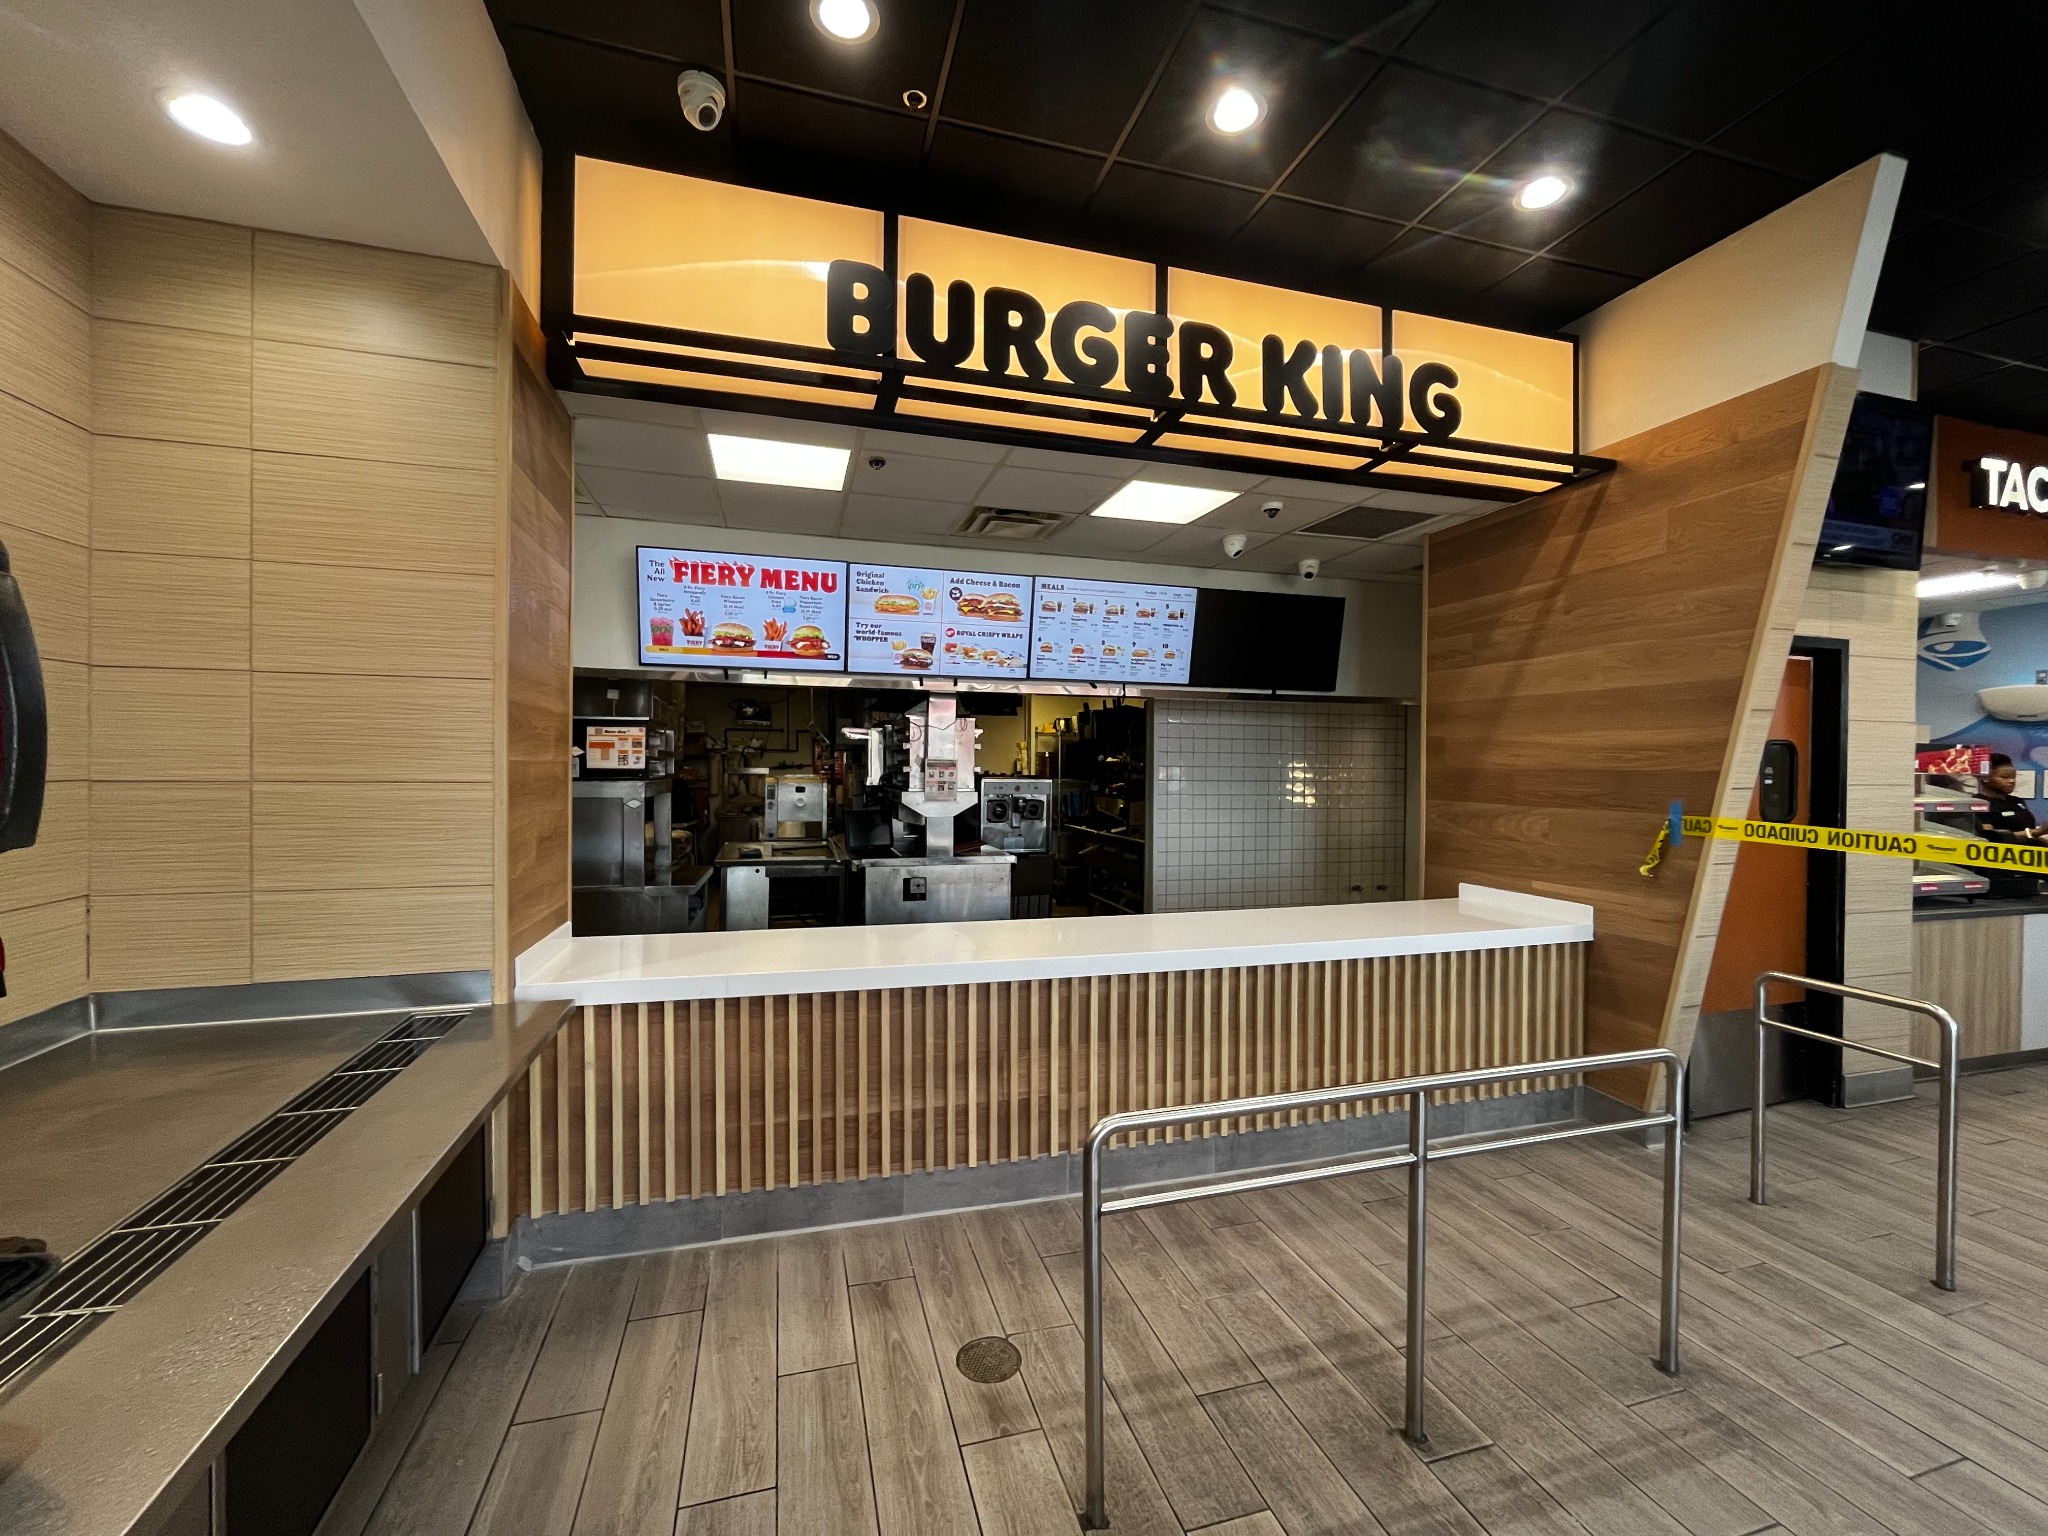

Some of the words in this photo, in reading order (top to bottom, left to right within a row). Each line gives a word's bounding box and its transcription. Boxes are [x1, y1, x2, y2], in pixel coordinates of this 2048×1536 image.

[826, 259, 1237, 406] BURGER
[1261, 334, 1461, 438] KING
[1980, 457, 2048, 513] TAC
[649, 559, 665, 567] The
[671, 557, 755, 587] FIERY
[760, 568, 838, 593] MENU
[856, 571, 885, 579] Original
